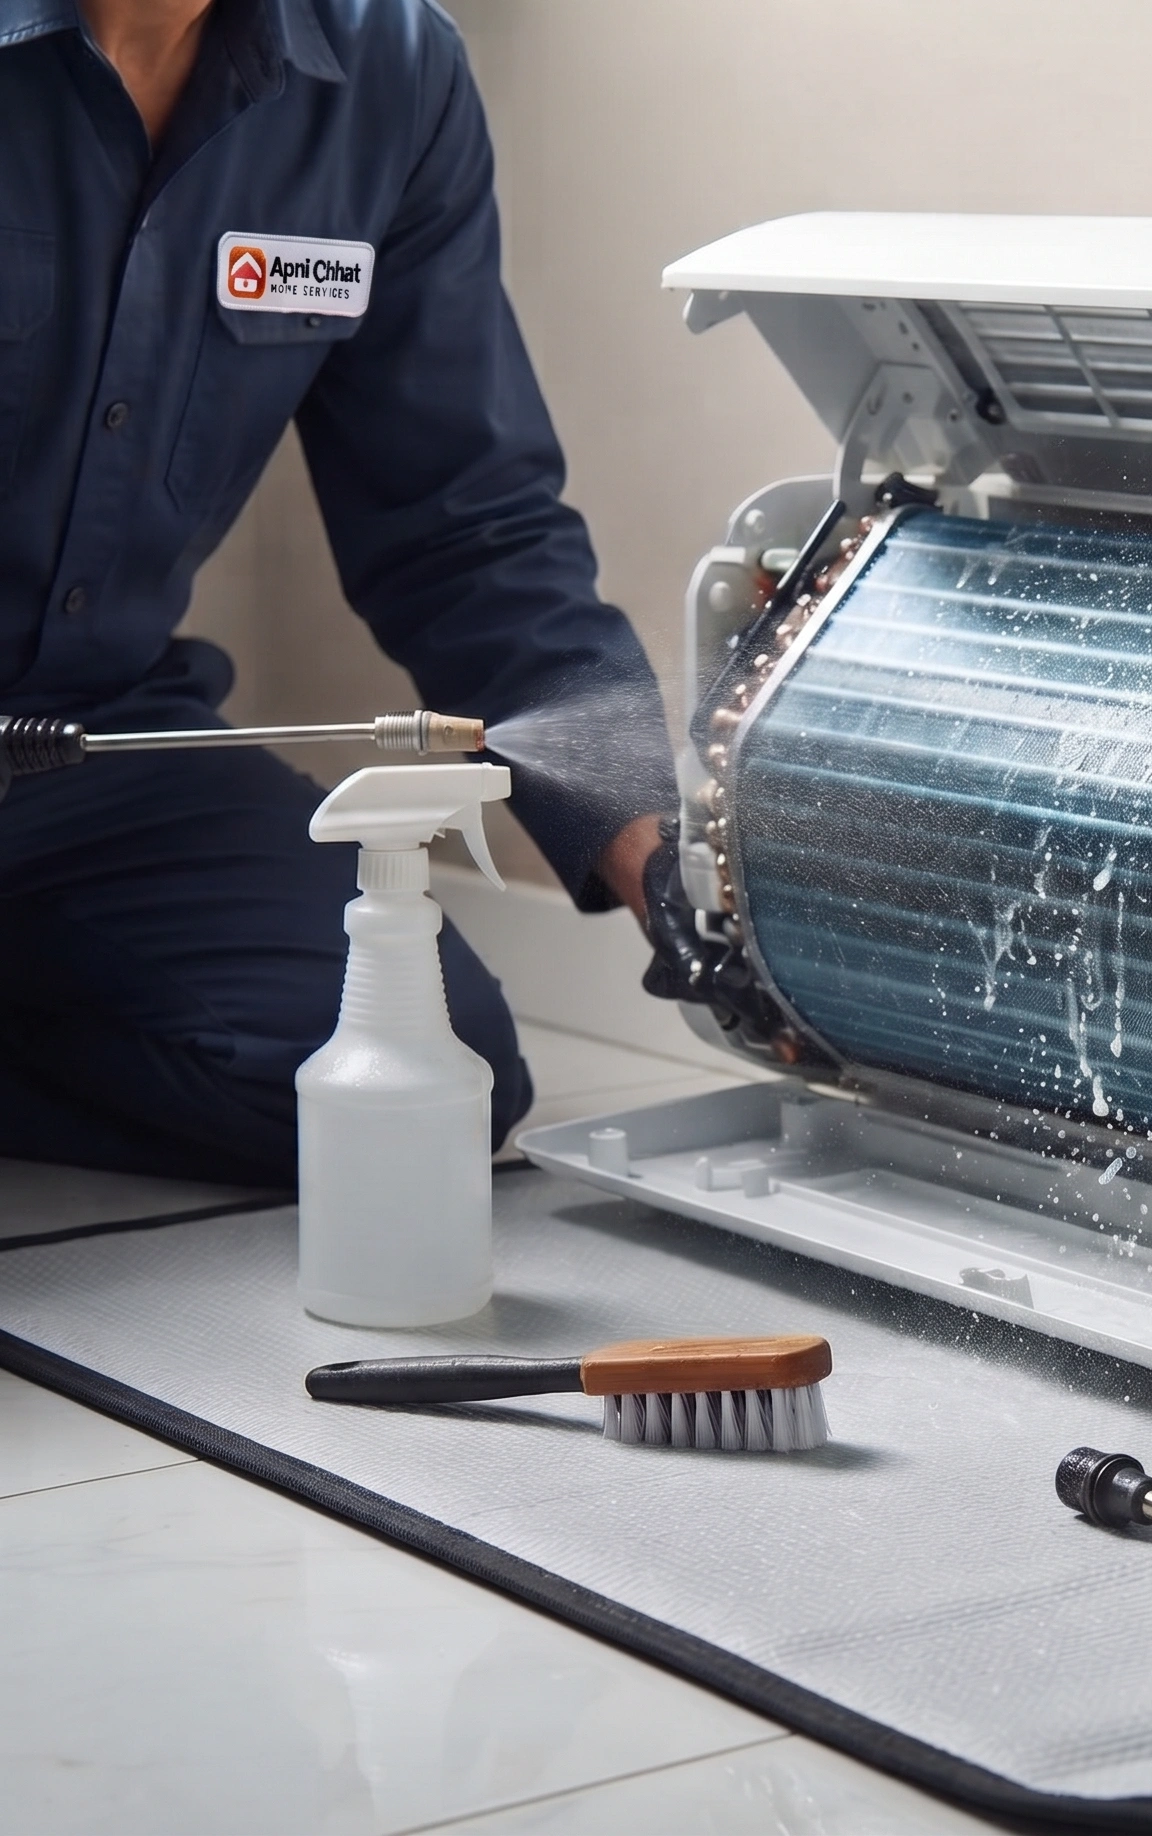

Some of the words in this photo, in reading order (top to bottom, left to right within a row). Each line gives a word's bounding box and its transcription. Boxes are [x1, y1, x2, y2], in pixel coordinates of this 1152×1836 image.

[270, 256, 311, 284] Apni
[313, 259, 361, 283] Chhat
[303, 286, 350, 299] SERVICES
